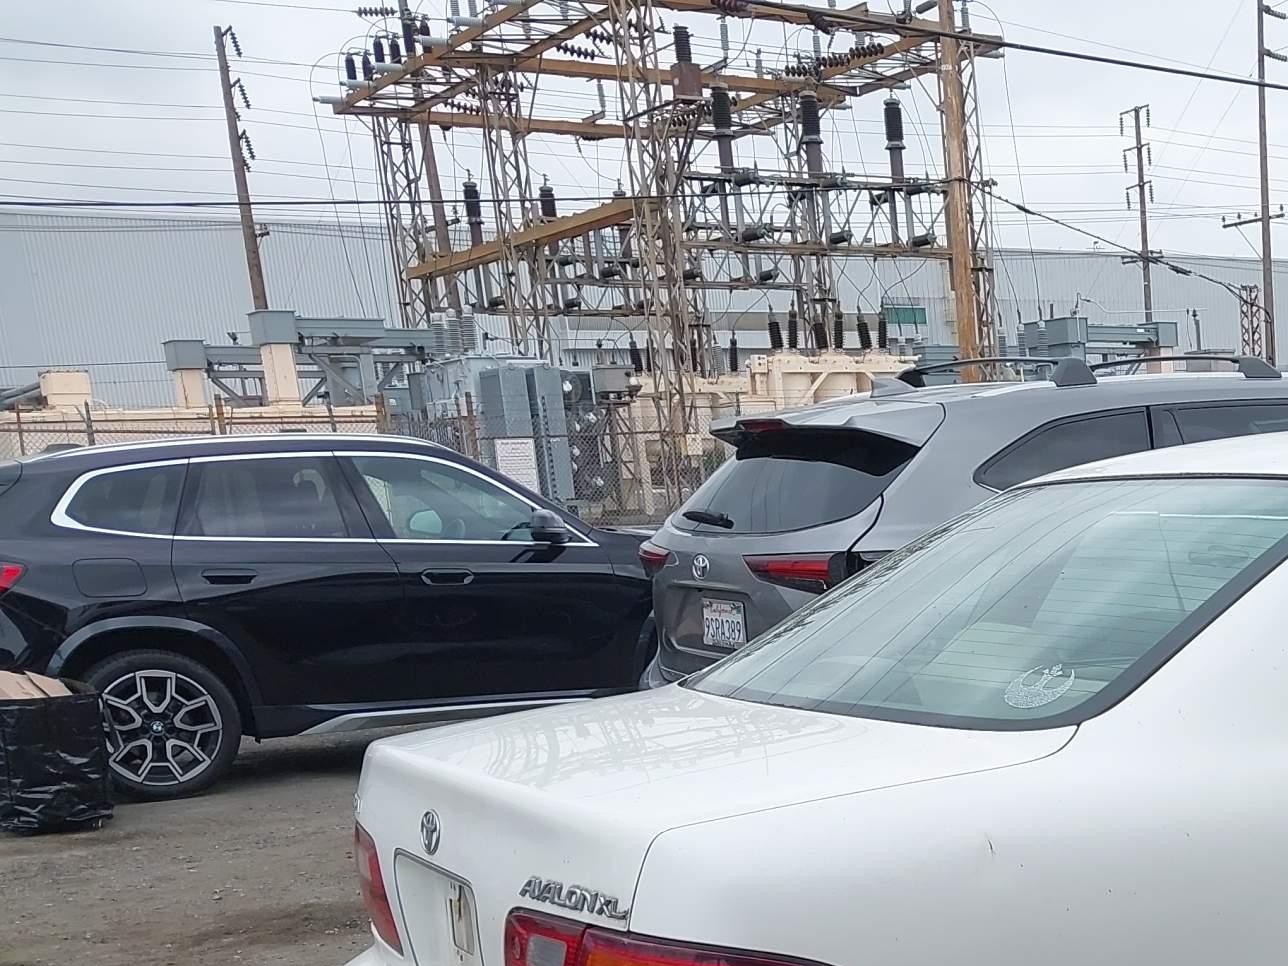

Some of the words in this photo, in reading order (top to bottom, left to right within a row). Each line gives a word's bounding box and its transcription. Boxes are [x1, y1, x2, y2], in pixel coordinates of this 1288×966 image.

[705, 617, 741, 641] 9SRA389
[519, 876, 599, 913] AVALON
[596, 896, 630, 920] XL
